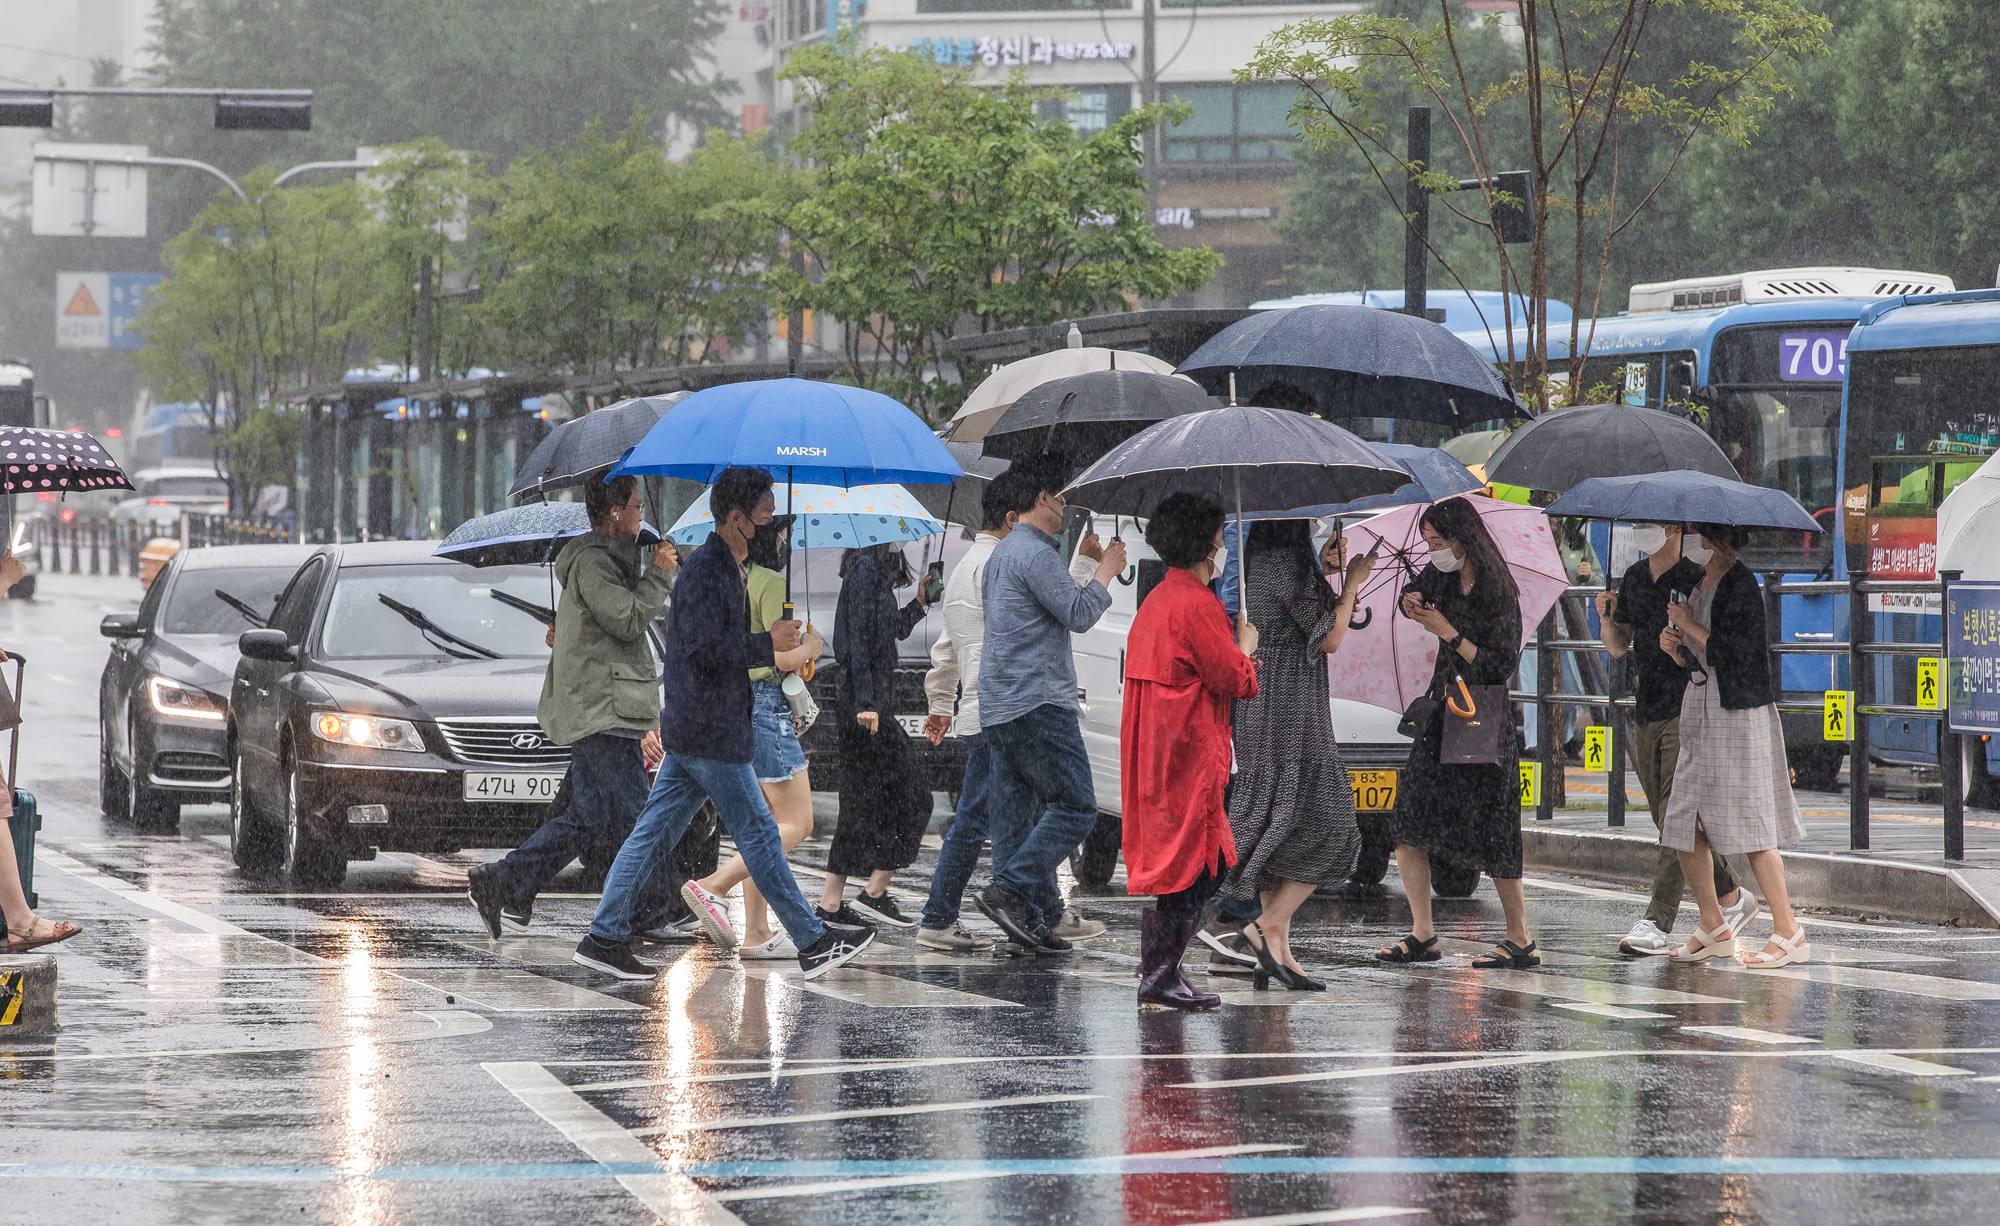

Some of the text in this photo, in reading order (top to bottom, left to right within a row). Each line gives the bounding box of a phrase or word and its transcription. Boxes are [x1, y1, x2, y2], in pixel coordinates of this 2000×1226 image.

[776, 446, 827, 456] MARSH
[1962, 655, 1993, 693] 잠깐이면
[476, 777, 515, 796] 47나
[1360, 772, 1378, 784] 83
[1352, 786, 1394, 809] 107
[693, 887, 714, 912] crocs
